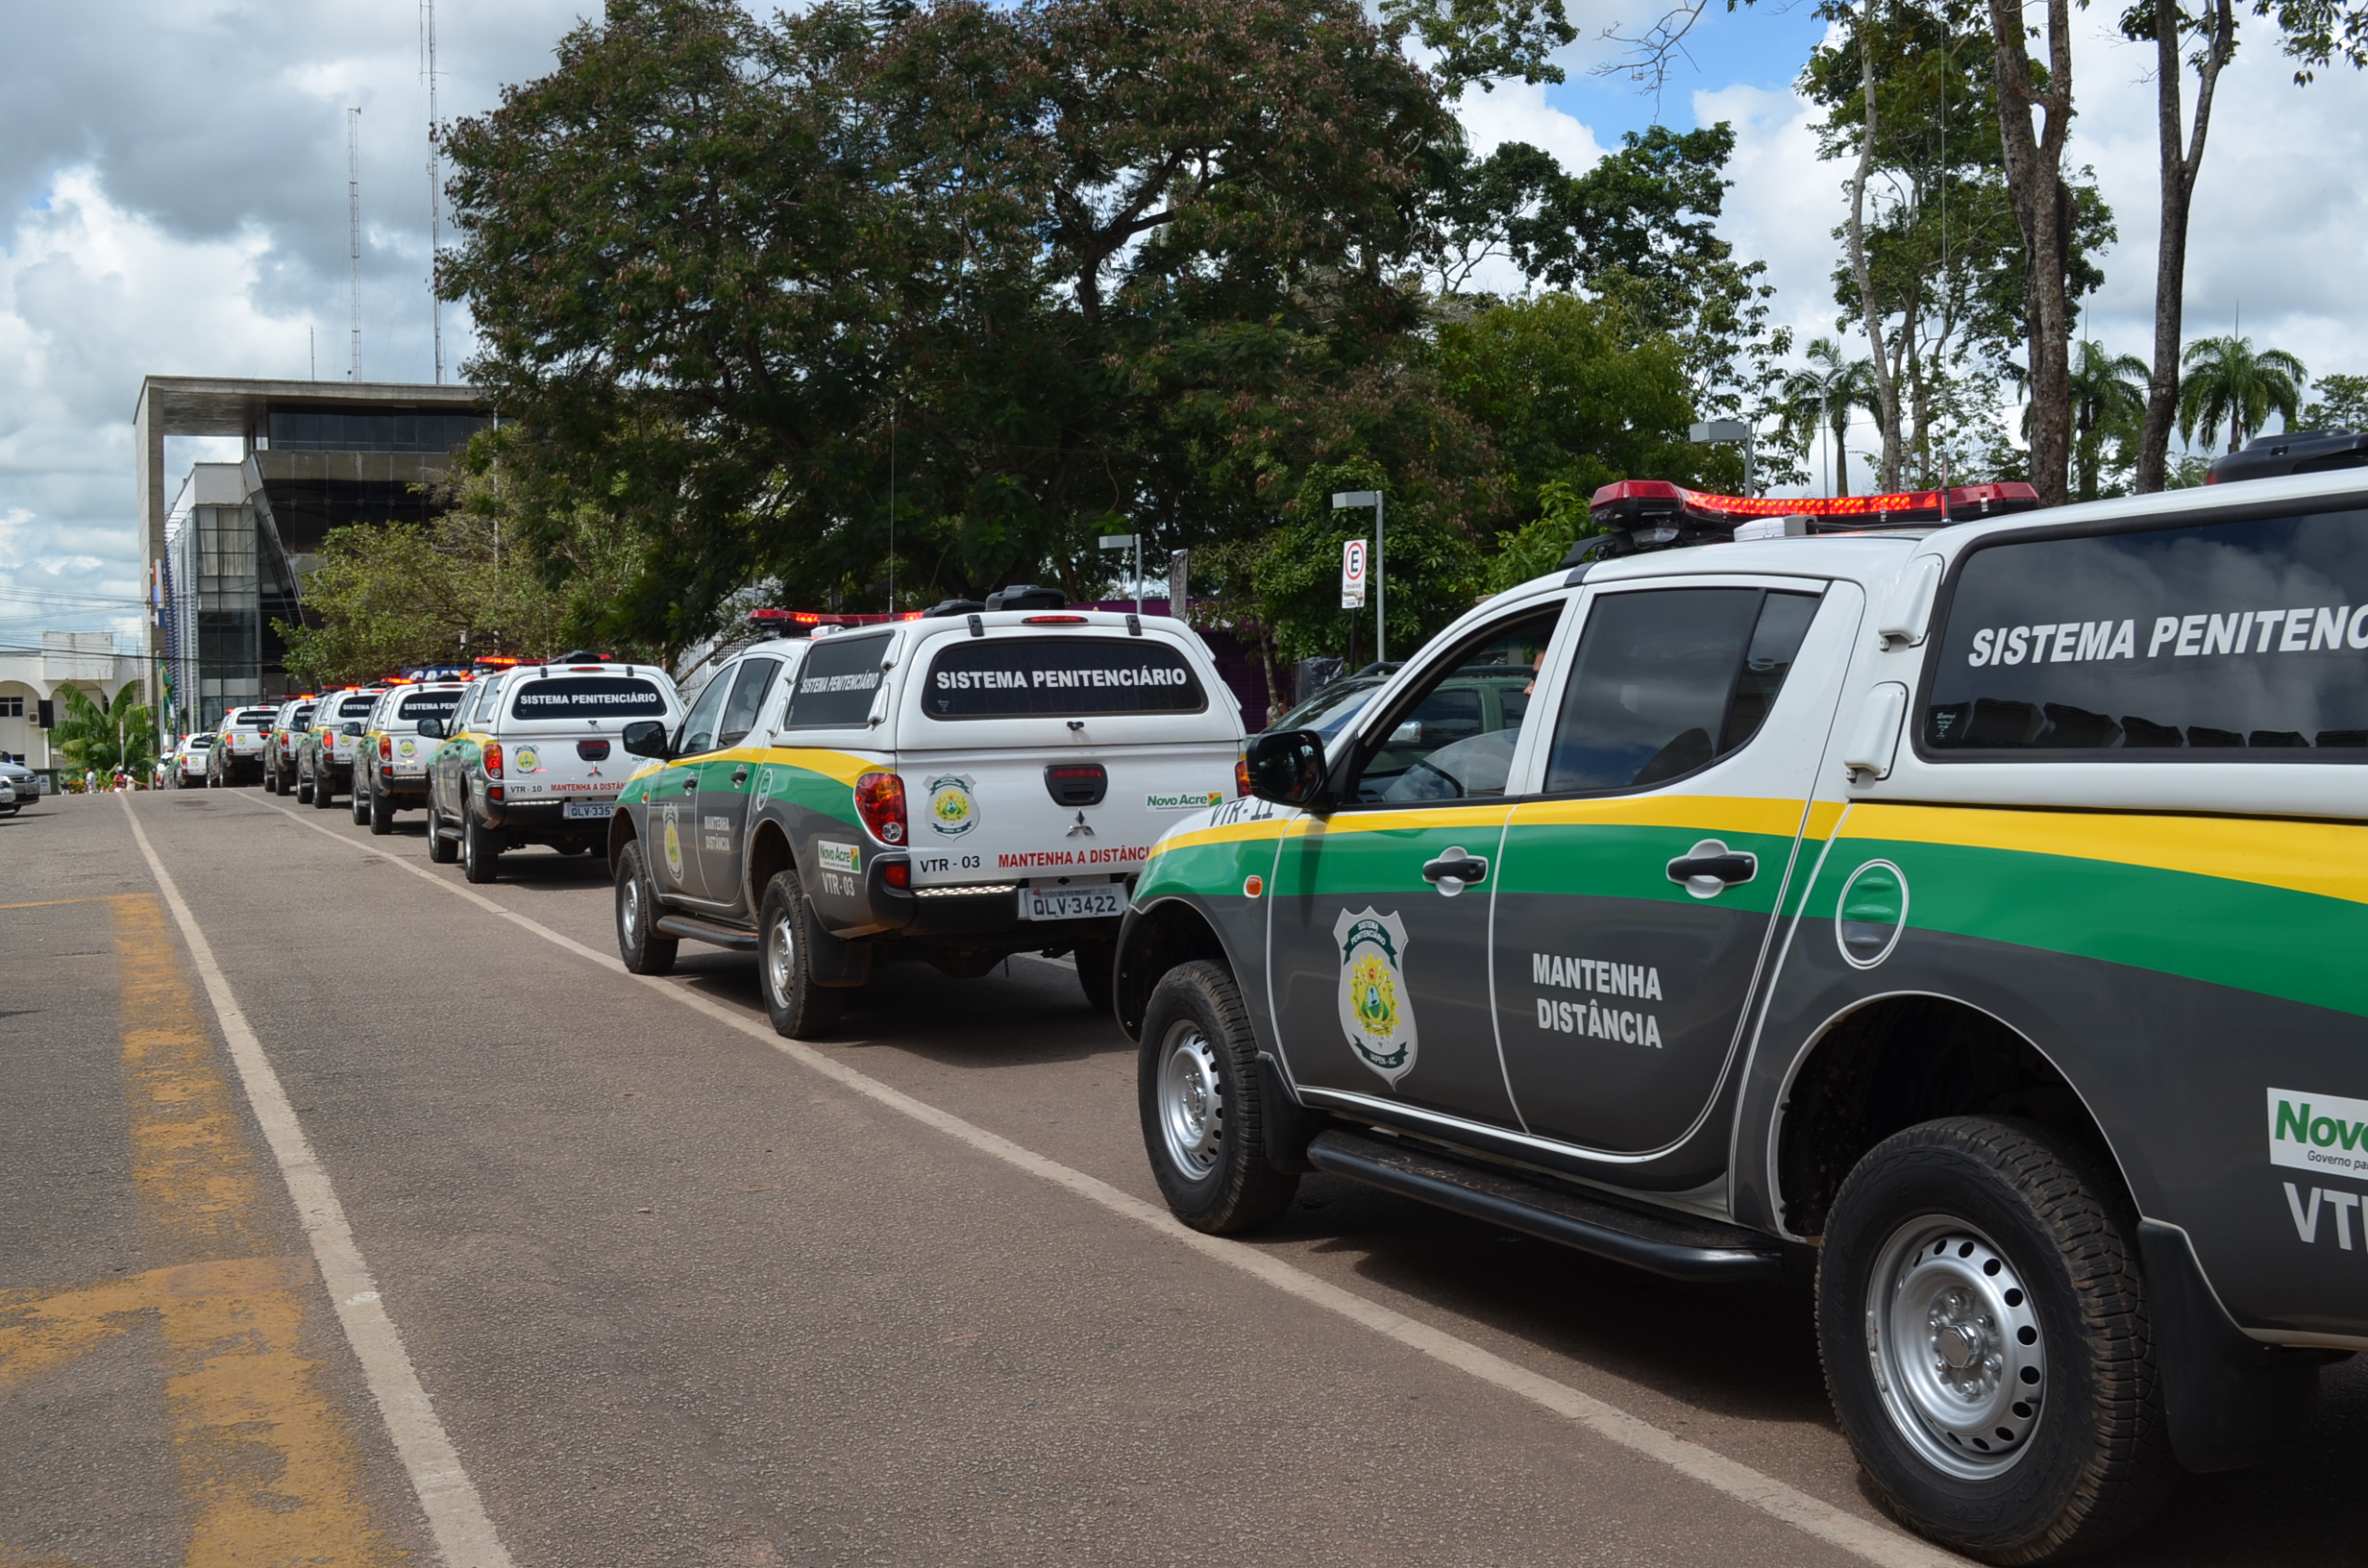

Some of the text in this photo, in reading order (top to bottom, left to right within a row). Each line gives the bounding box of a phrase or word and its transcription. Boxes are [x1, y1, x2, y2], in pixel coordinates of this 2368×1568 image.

[1350, 551, 1360, 573] E
[1968, 619, 2134, 667] SISTEMA
[801, 670, 879, 694] SISTEMA PENITENCIÁRIO
[936, 665, 1187, 689] SISTEMA PENITENCIÁRIO
[520, 692, 657, 704] SISTEMA PENITENCIÁRIO
[551, 783, 591, 792] MANTENHA
[1147, 794, 1208, 807] Novo Acre
[704, 816, 729, 832] MANTENHA
[705, 833, 730, 851] DISTÂNCIA
[820, 845, 851, 863] Novo Acre
[999, 850, 1073, 869] MANTENHA
[1076, 850, 1086, 864] A
[920, 858, 950, 873] VTR
[962, 855, 981, 870] 03
[1358, 920, 1379, 931] SISTEMA
[1350, 929, 1387, 946] PENITENCIÁRIO
[1533, 953, 1663, 1000] MANTENHA
[1537, 998, 1663, 1048] DISTÂNCIA
[2307, 1150, 2351, 1167] Governo
[2282, 1182, 2368, 1254] VT
